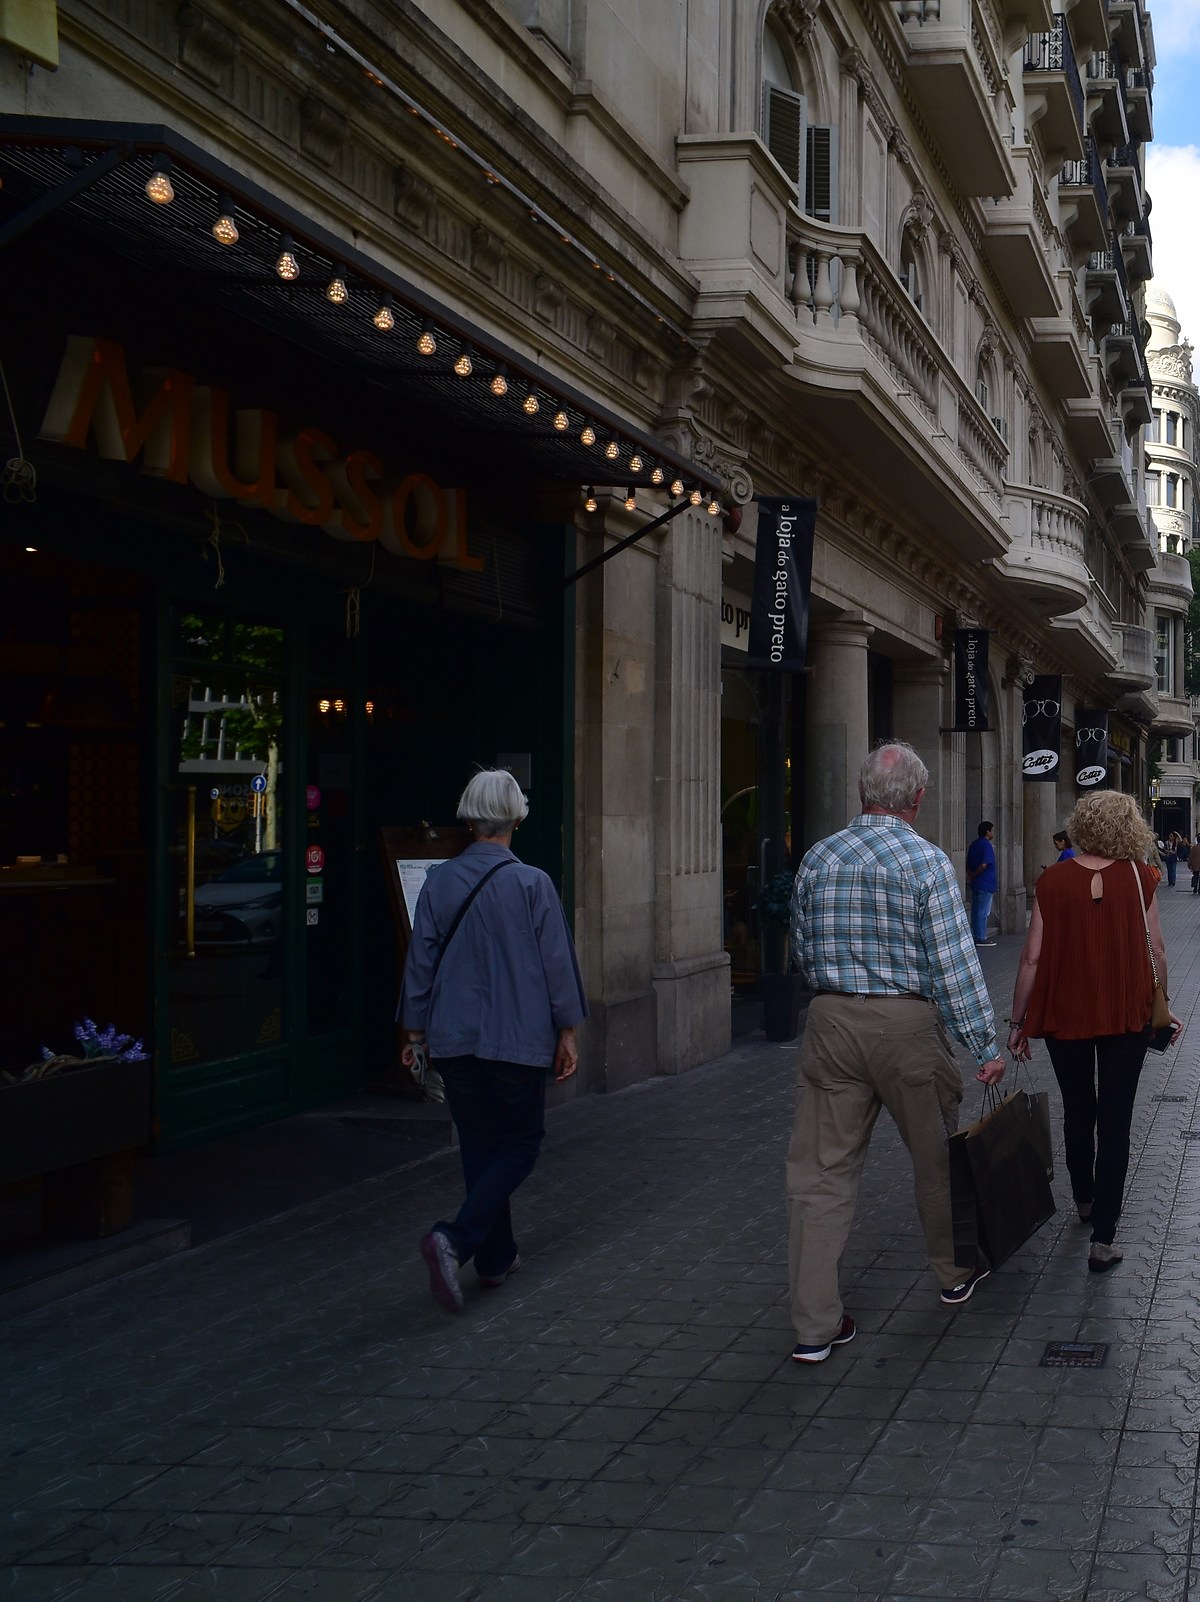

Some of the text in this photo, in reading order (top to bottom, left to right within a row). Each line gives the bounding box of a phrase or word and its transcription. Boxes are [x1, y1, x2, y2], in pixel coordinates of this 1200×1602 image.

[36, 335, 485, 572] MUSSOL
[768, 504, 797, 663] a loja do gato preto
[965, 640, 978, 659] loja
[967, 661, 975, 671] do
[965, 672, 976, 696] gato
[965, 697, 977, 727] preto
